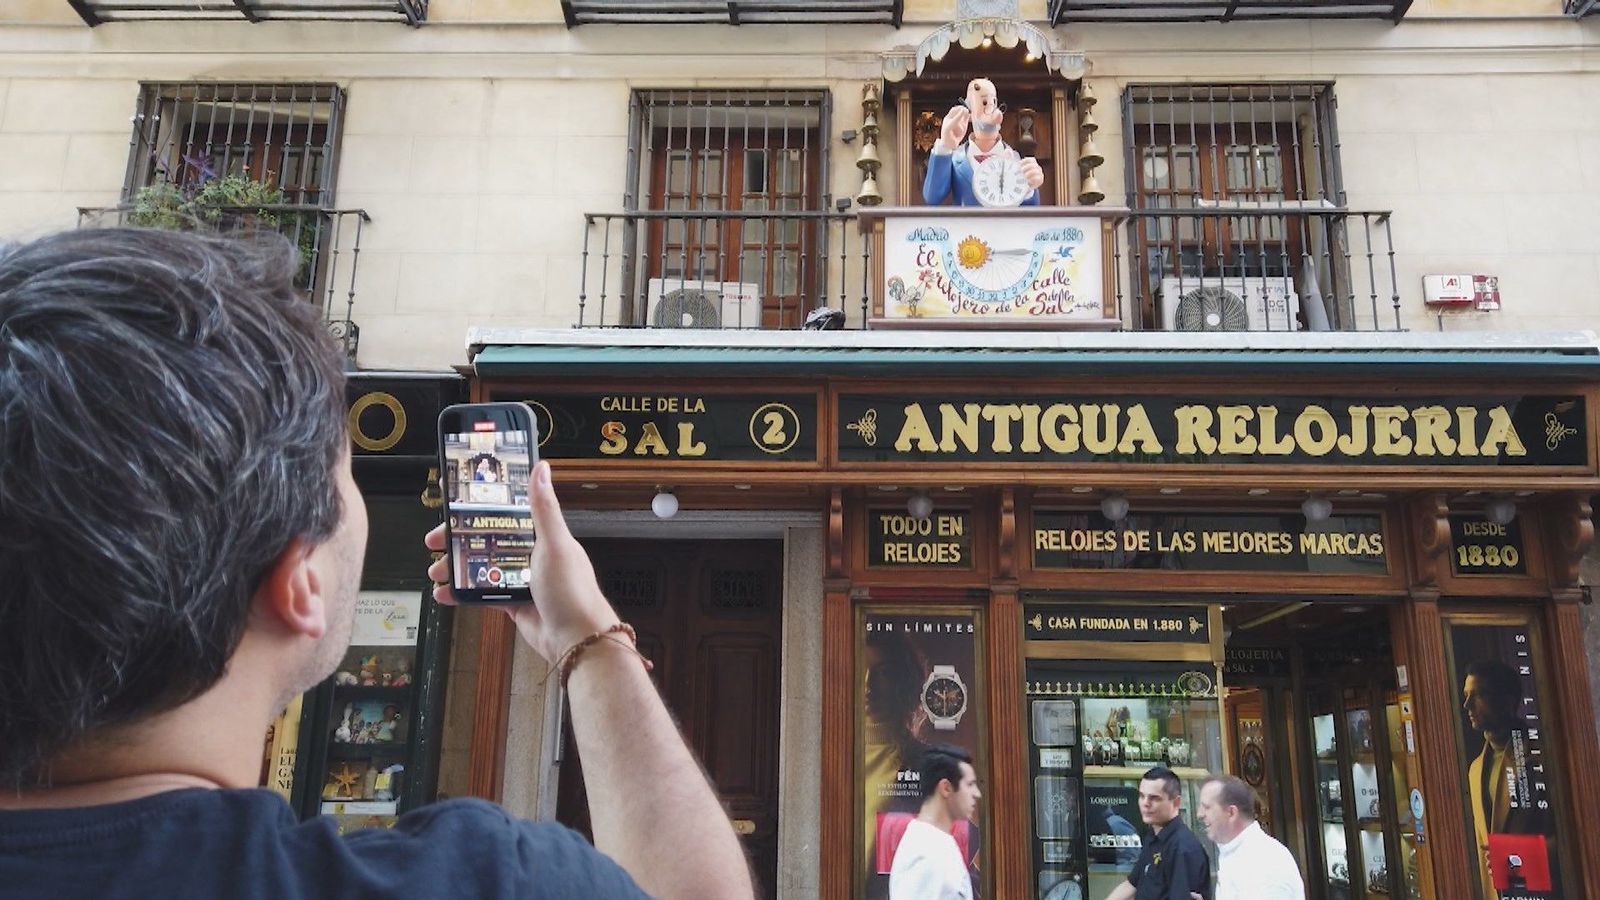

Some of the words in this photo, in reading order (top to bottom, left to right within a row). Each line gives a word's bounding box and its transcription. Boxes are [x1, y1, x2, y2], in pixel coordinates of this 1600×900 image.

[907, 227, 950, 241] Madrid
[1062, 227, 1084, 241] 1880
[916, 243, 938, 267] El
[1032, 267, 1071, 291] calle
[935, 271, 990, 315] relojero
[995, 301, 1012, 314] de
[1015, 294, 1030, 308] la
[1029, 290, 1074, 315] Sal
[600, 397, 651, 412] CALLE
[656, 398, 678, 412] DE
[683, 399, 706, 413] LA
[599, 421, 707, 456] SAL
[762, 412, 787, 444] 2
[895, 403, 1163, 454] ANTIGUA
[1174, 404, 1527, 457] RELOJERIA
[473, 516, 519, 528] ANTIGUA
[880, 515, 932, 537] TODO
[938, 516, 963, 536] EN
[1463, 521, 1507, 537] DESDE
[884, 542, 961, 563] RELOJES
[1035, 529, 1118, 551] RELOJES
[1123, 530, 1151, 551] DE
[1157, 531, 1197, 553] LAS
[1202, 531, 1294, 554] MEJORES
[1300, 532, 1384, 556] MARCAS
[1457, 545, 1519, 567] 1880
[866, 623, 893, 632] SIN
[1048, 617, 1077, 630] CASA
[1080, 617, 1130, 630] FUNDADA
[1134, 618, 1149, 630] EN
[1152, 619, 1183, 631] 1.880
[1515, 634, 1531, 675] SIN
